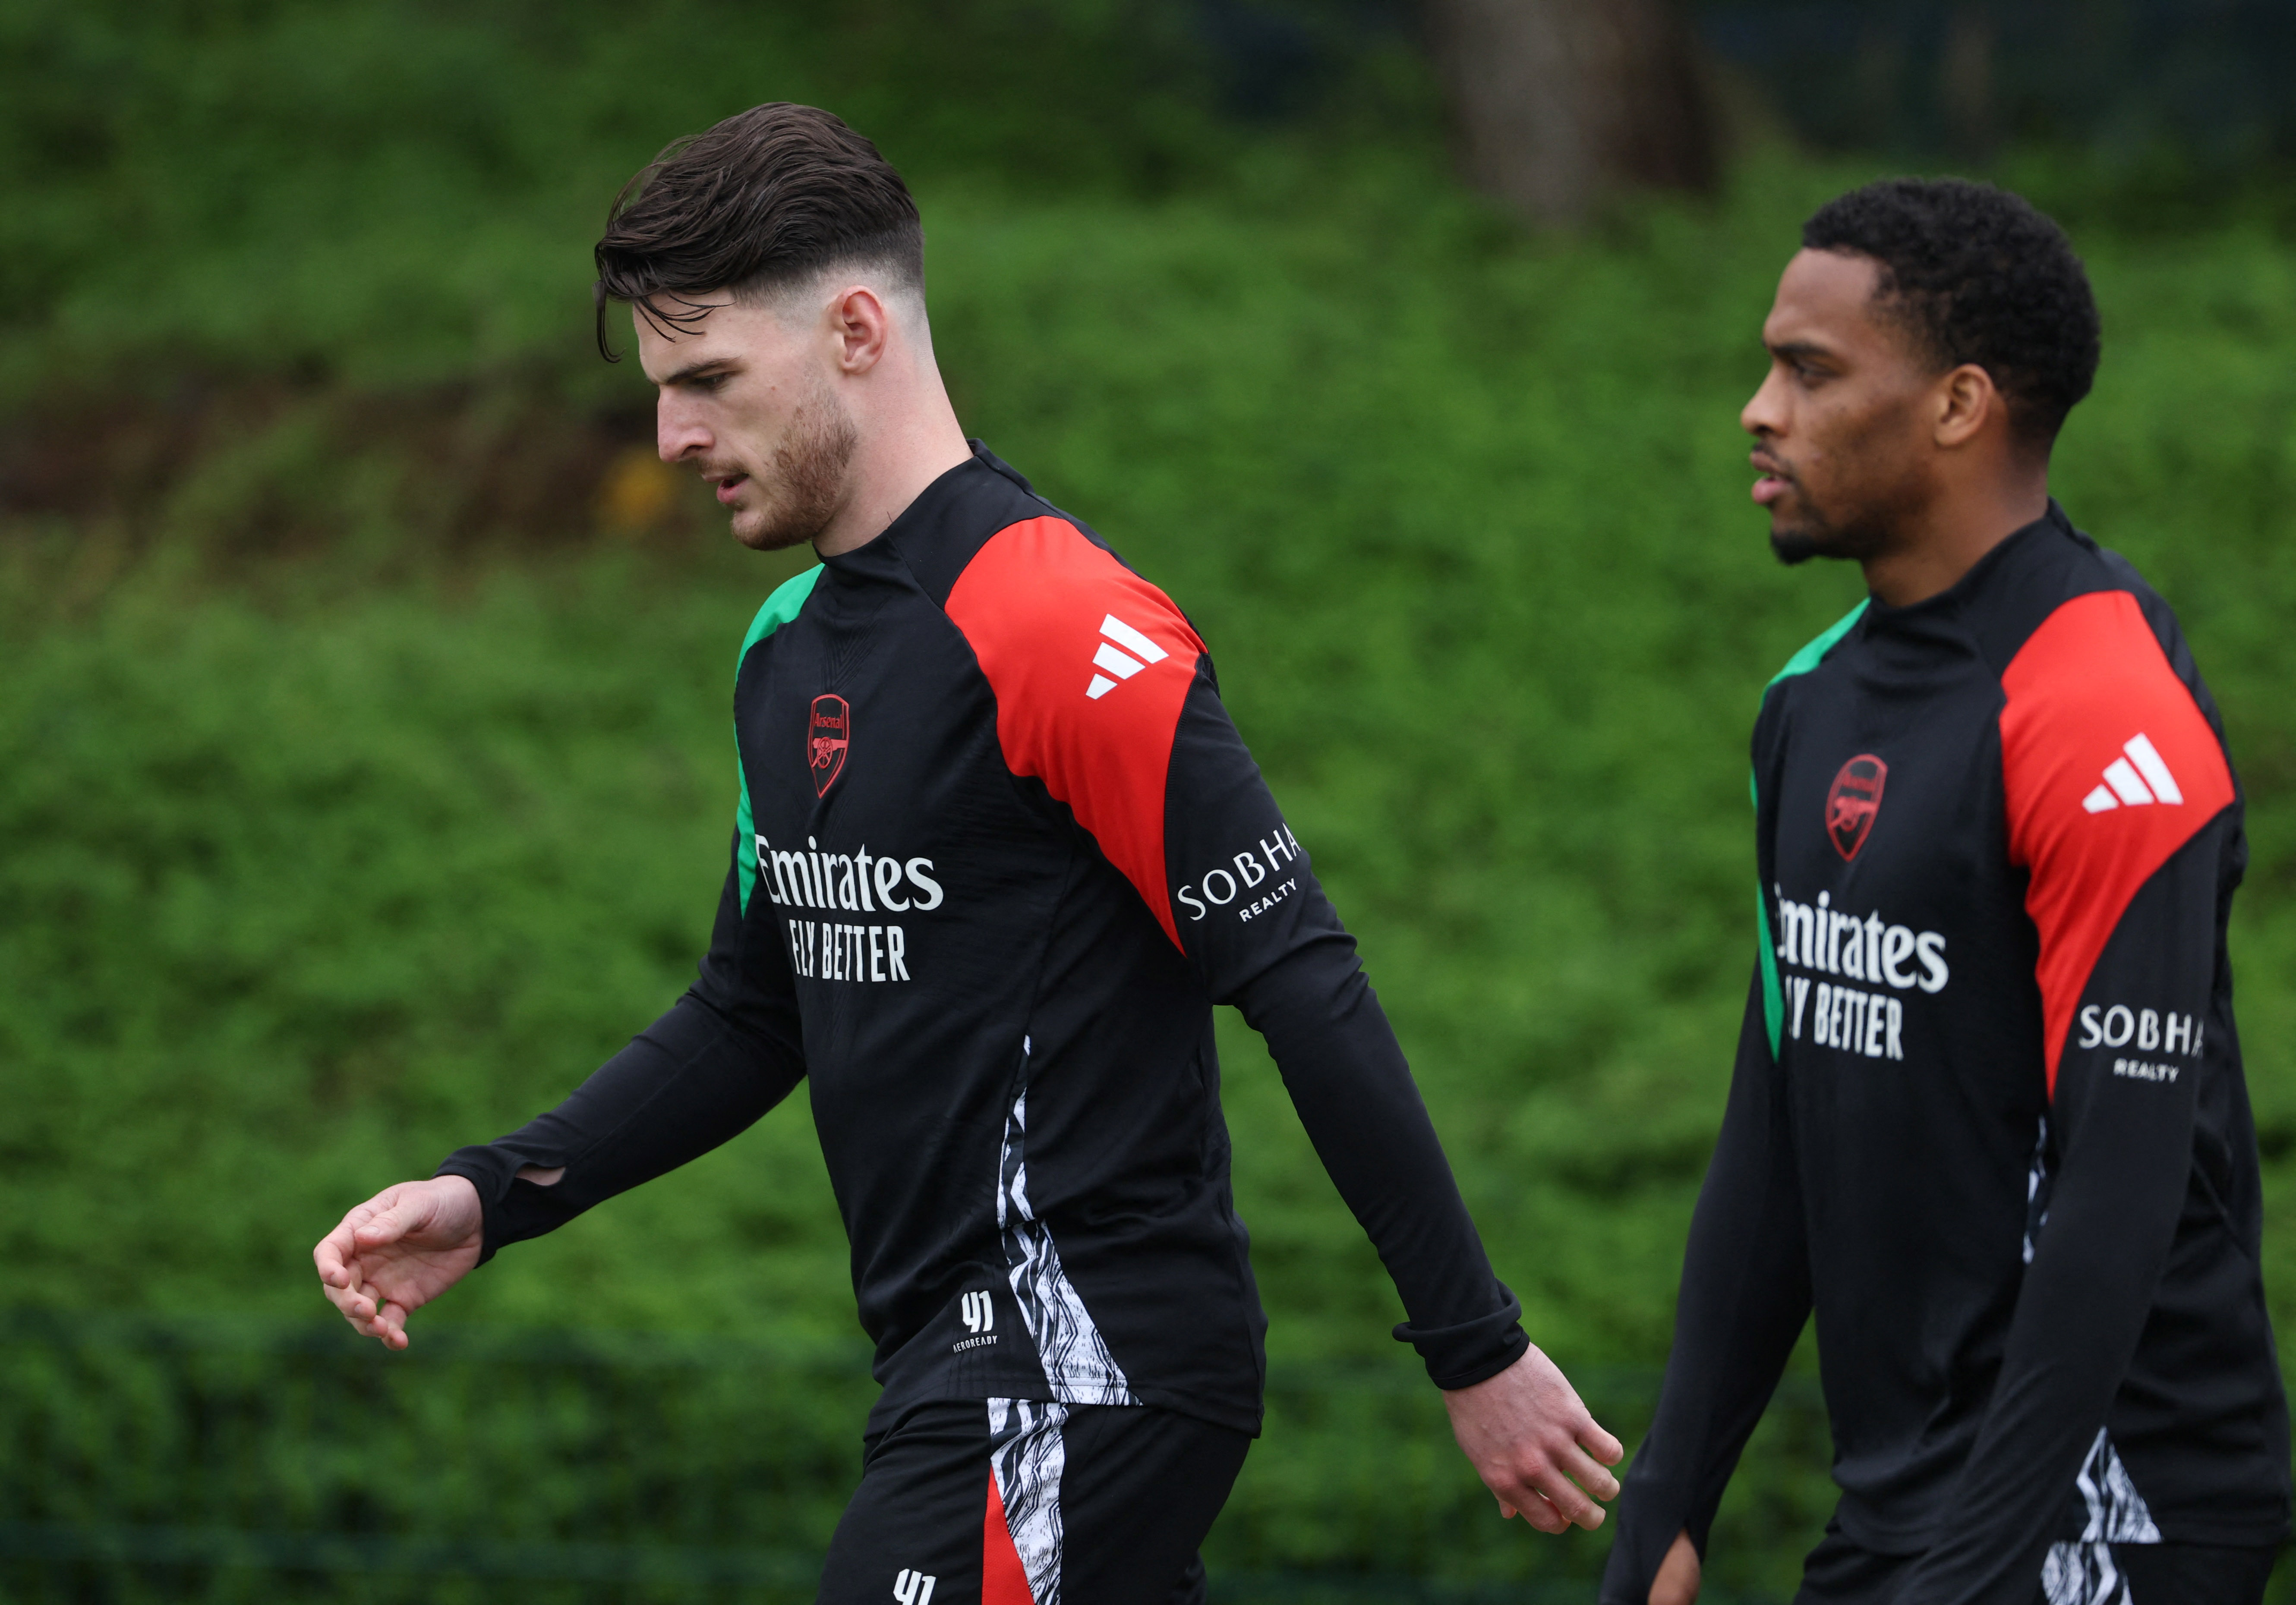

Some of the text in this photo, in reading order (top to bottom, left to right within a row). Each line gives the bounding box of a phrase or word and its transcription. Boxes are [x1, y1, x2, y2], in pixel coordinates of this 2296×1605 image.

[814, 713, 844, 729] Arsenal
[755, 834, 944, 912] Emirates
[1177, 822, 1301, 921] SOBHA
[1239, 878, 1296, 922] REALTY
[788, 919, 911, 982] FLY BETTER
[1774, 881, 1949, 993] mirates
[1813, 982, 1904, 1061] BETTER
[2113, 1058, 2179, 1083] REALTY
[961, 1290, 993, 1333] 41
[952, 1335, 998, 1353] AEROREADY
[893, 1568, 937, 1605] 41
